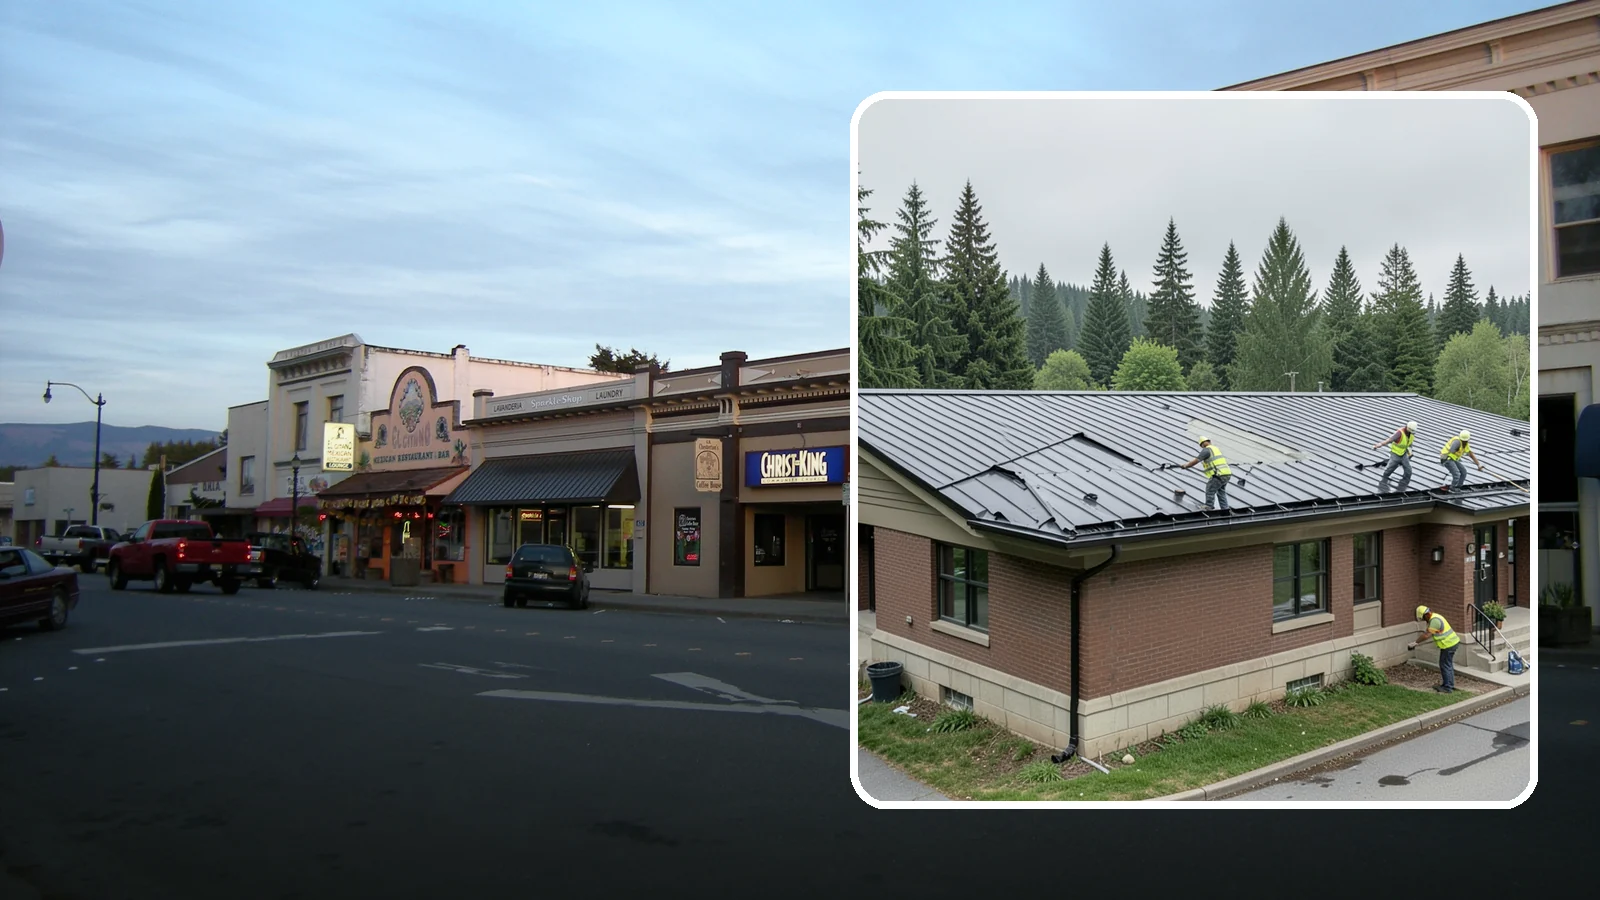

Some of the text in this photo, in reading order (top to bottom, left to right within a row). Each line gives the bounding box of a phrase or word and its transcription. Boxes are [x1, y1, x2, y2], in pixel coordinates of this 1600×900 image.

[595, 389, 624, 400] LAUNDRY
[493, 402, 523, 413] LAVANDERIA
[530, 394, 583, 409] Sparkle Shop
[373, 455, 396, 464] MEXICAN
[397, 452, 433, 462] RESTAURANT
[761, 450, 827, 478] CHRIST KING
